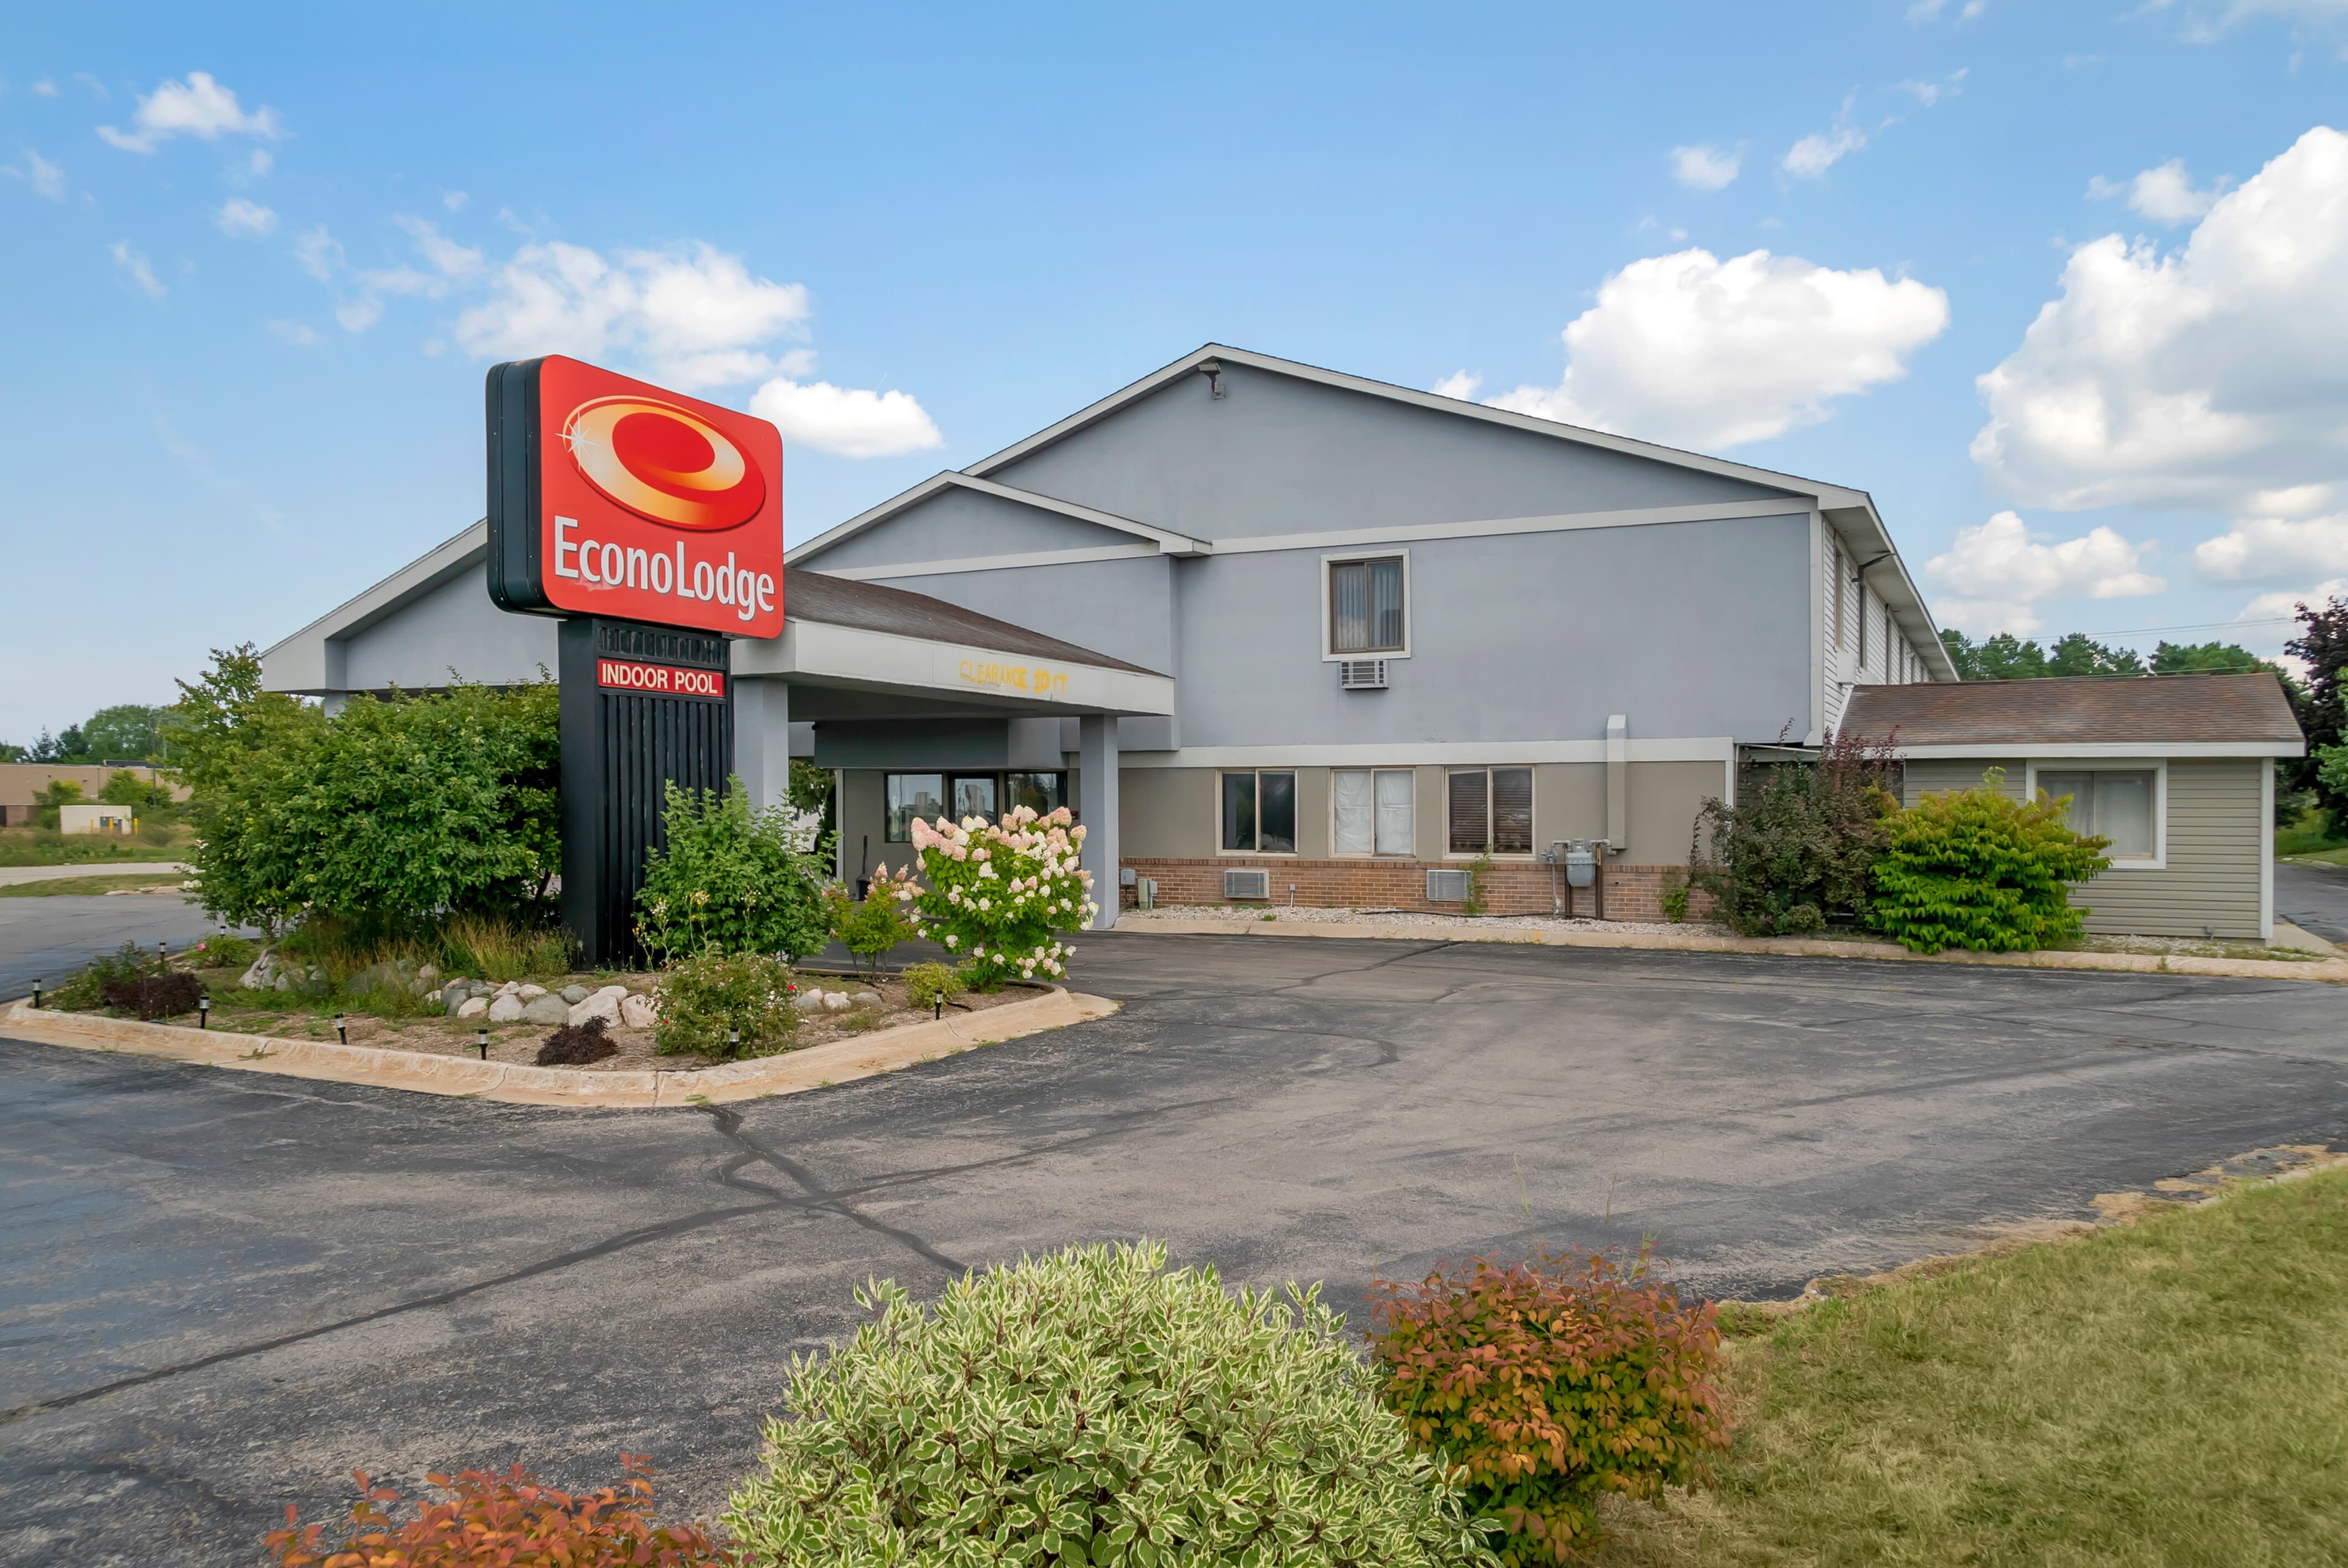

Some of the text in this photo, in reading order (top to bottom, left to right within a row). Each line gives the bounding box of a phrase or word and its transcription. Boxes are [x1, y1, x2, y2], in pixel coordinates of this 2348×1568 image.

[555, 515, 775, 622] EconoLodge
[602, 663, 718, 694] INDOOR POOL
[959, 660, 1028, 690] CLEARANCE
[1052, 674, 1069, 693] FT
